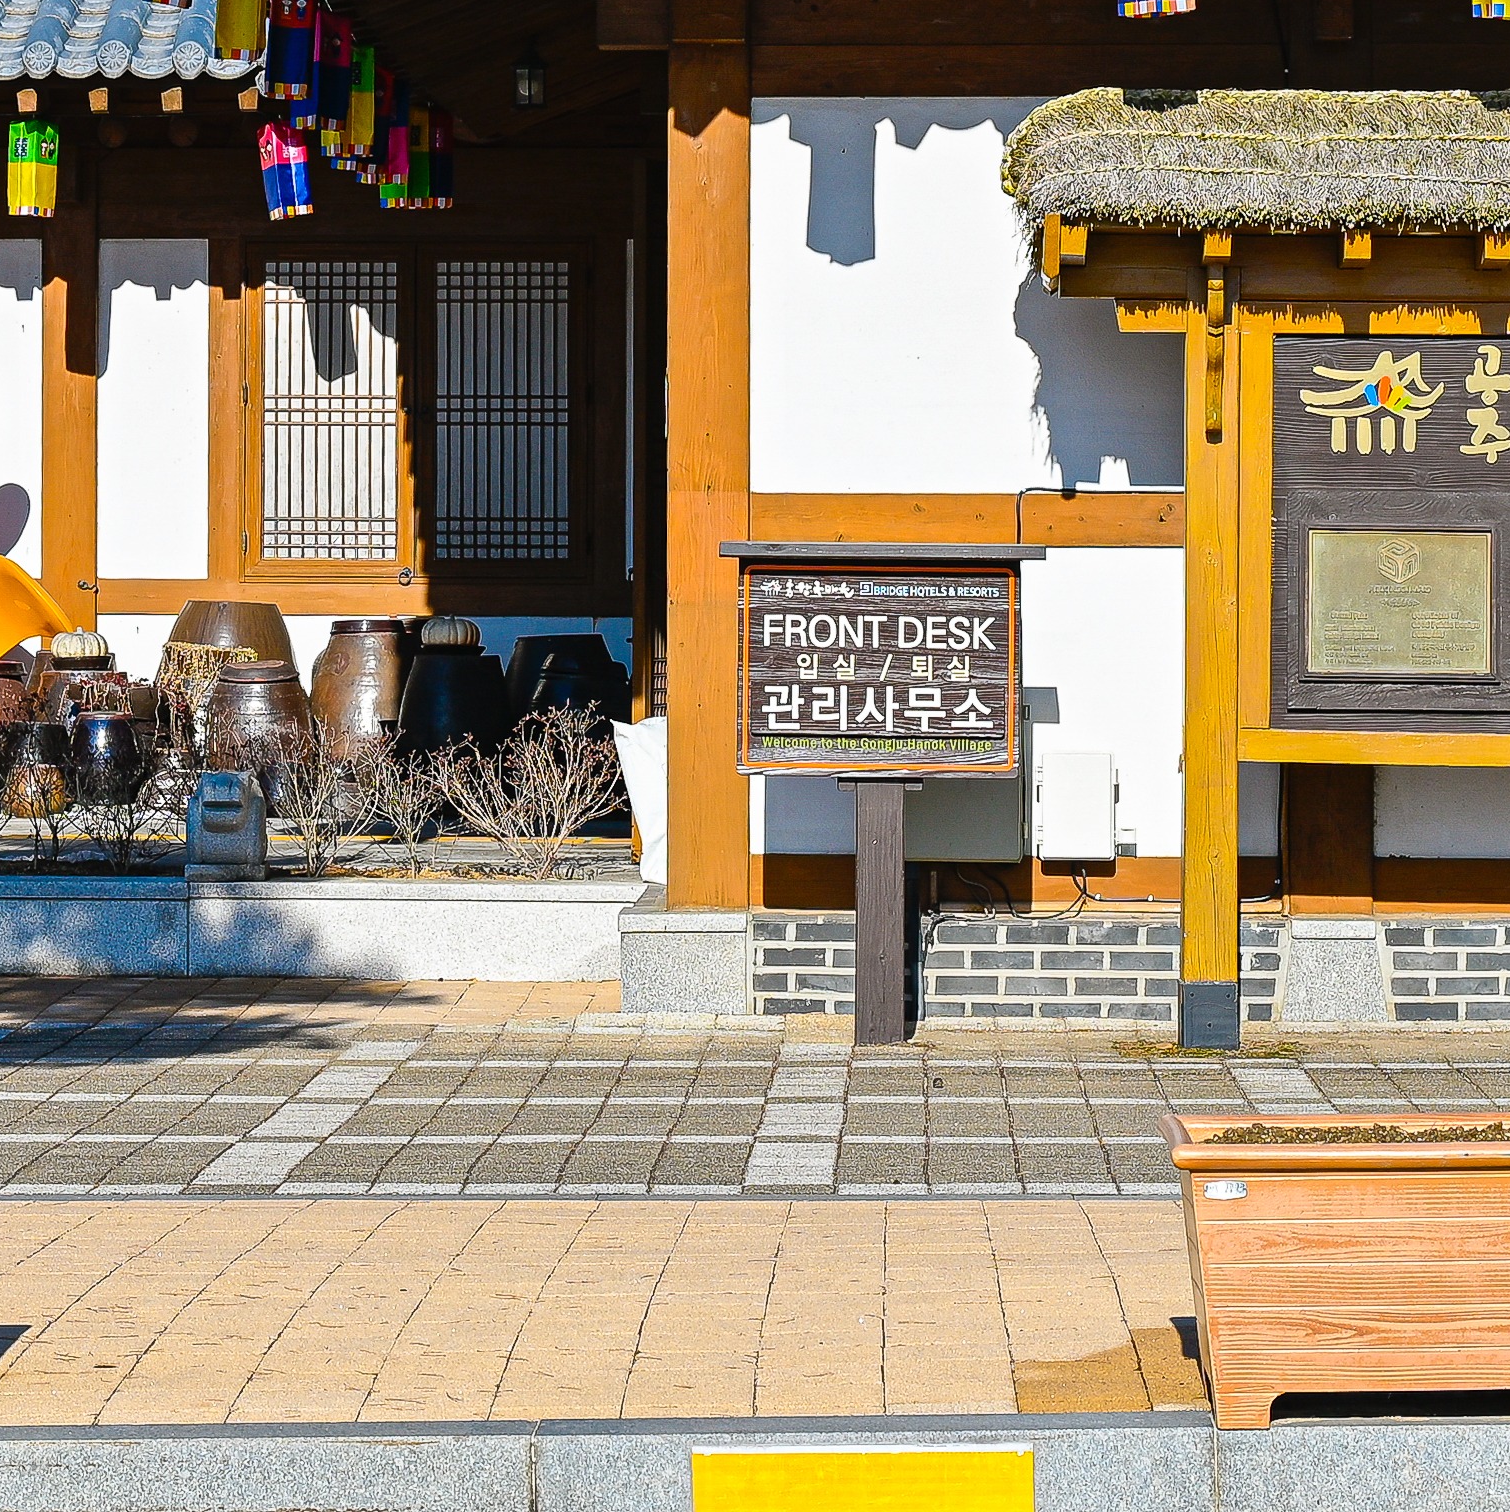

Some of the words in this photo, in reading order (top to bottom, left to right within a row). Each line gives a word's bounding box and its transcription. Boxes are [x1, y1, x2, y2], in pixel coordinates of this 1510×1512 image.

[795, 580, 855, 598] 한옥마을
[874, 584, 909, 597] BRIDGE
[910, 584, 947, 597] HOTELS
[948, 585, 955, 597] &
[957, 585, 1000, 598] RESORTS
[762, 614, 888, 648] FRONT
[898, 615, 997, 650] DESK
[797, 653, 857, 680] 입실
[879, 653, 894, 681] /
[910, 655, 971, 682] 퇴실
[761, 685, 994, 731] 관리사무소
[761, 736, 817, 750] Welcome
[821, 737, 832, 750] to
[836, 737, 856, 750] the
[860, 737, 903, 752] Gongju
[908, 738, 947, 751] Hanok
[950, 738, 992, 753] Village
